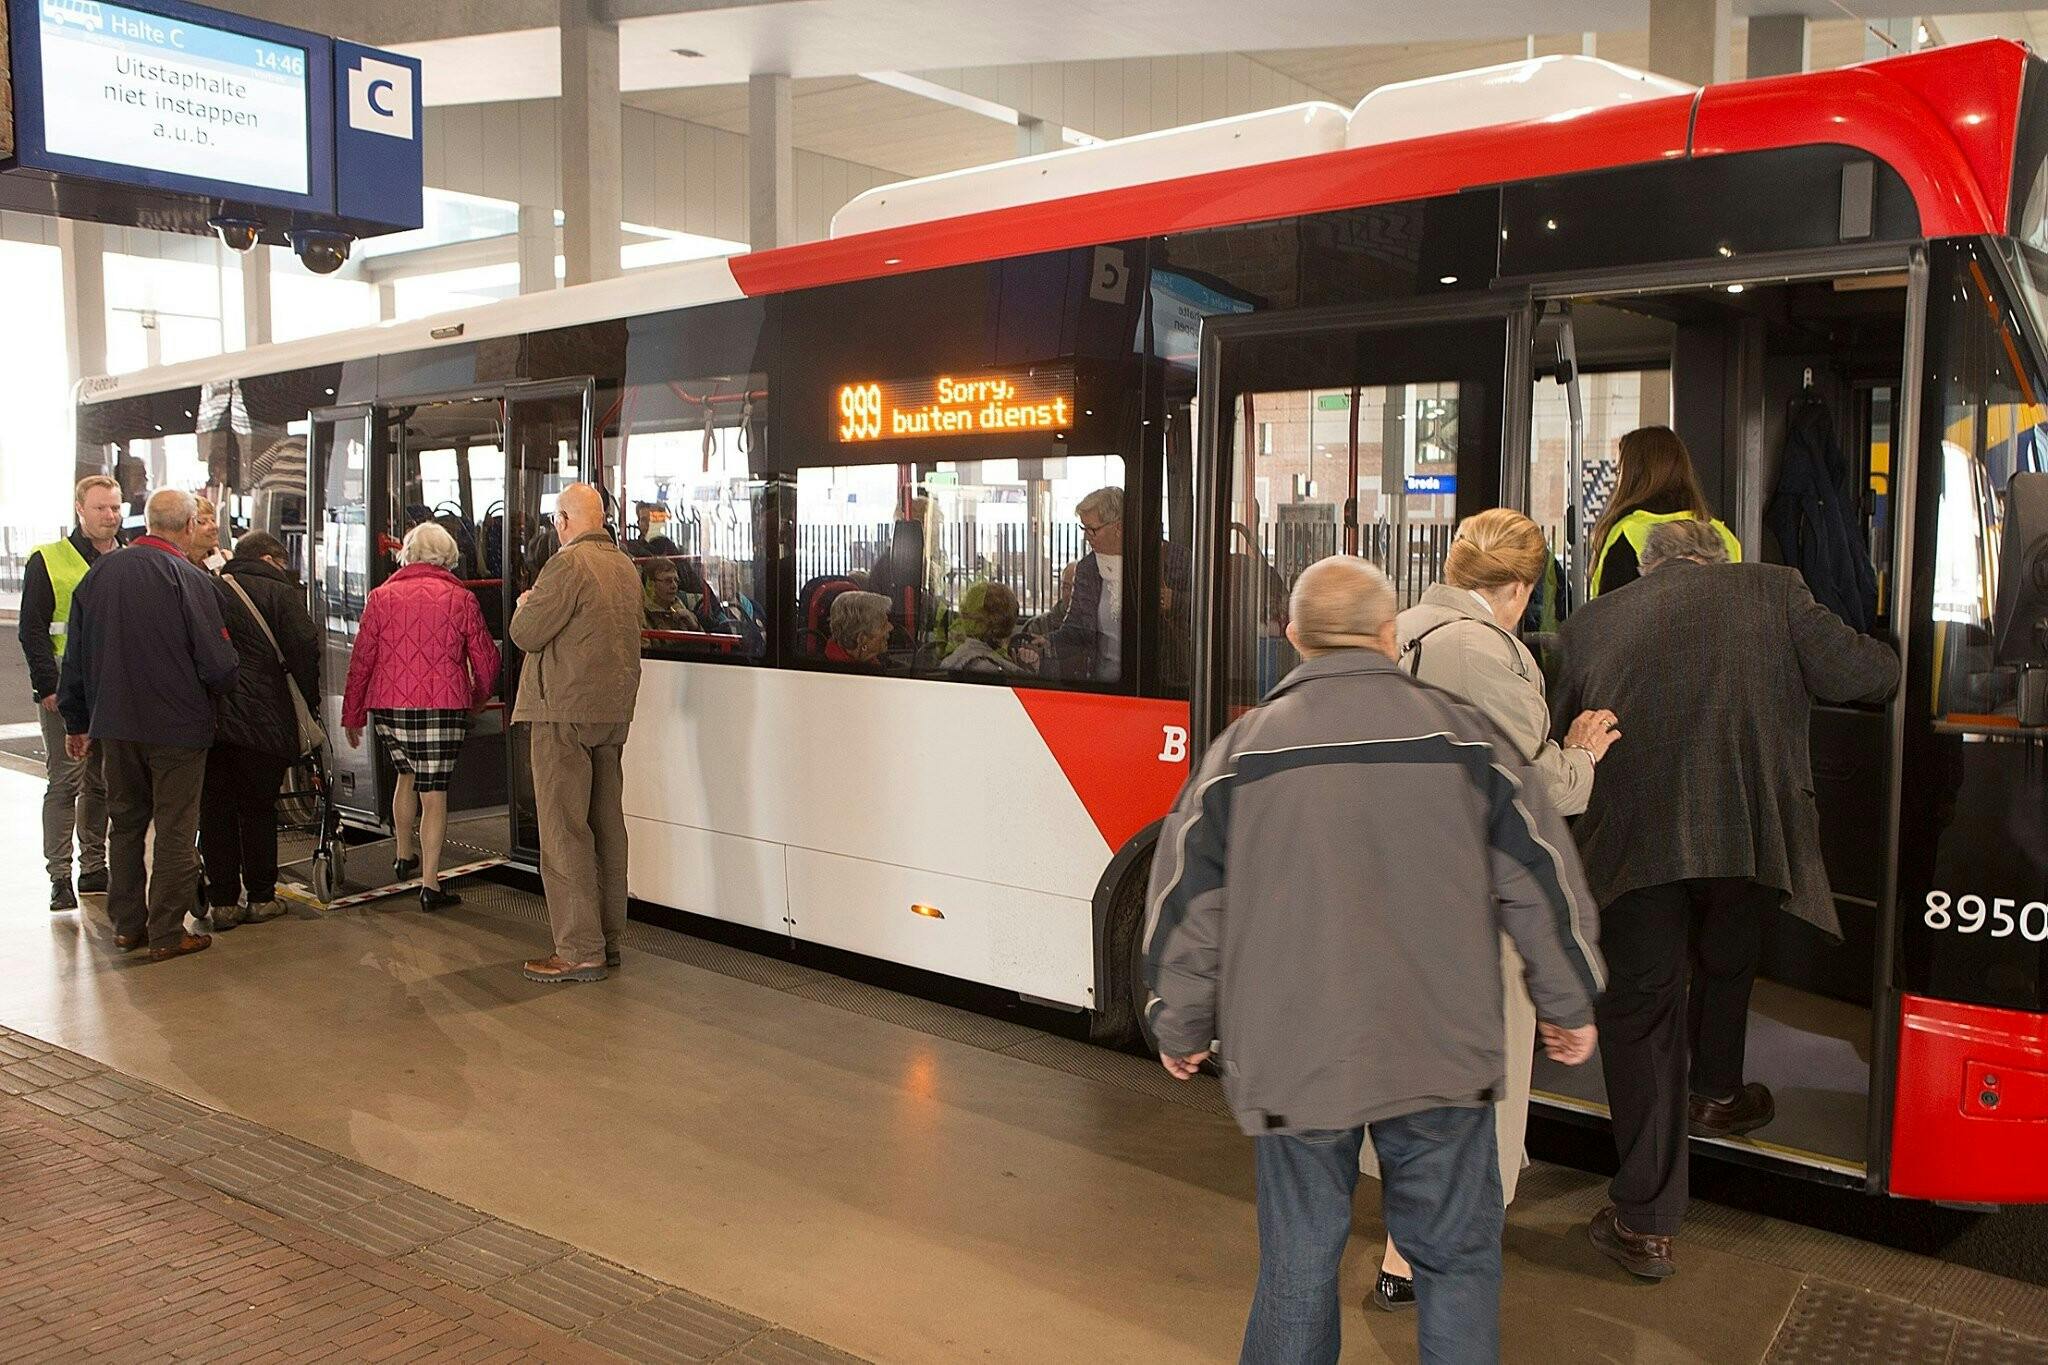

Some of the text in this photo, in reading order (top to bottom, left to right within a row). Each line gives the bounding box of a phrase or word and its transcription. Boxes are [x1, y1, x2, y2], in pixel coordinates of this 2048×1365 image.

[112, 15, 165, 44] Halte
[170, 29, 185, 49] C
[116, 55, 247, 99] Uitstaphalte
[255, 48, 302, 76] 14:46
[104, 83, 259, 128] niet instappen
[367, 79, 394, 117] C
[153, 121, 216, 147] a.u.b.
[938, 377, 1015, 404] Sorry,
[840, 383, 882, 439] 999
[892, 397, 1067, 434] buiten dienst
[1158, 725, 1188, 763] B
[1923, 890, 2048, 942] 8950
